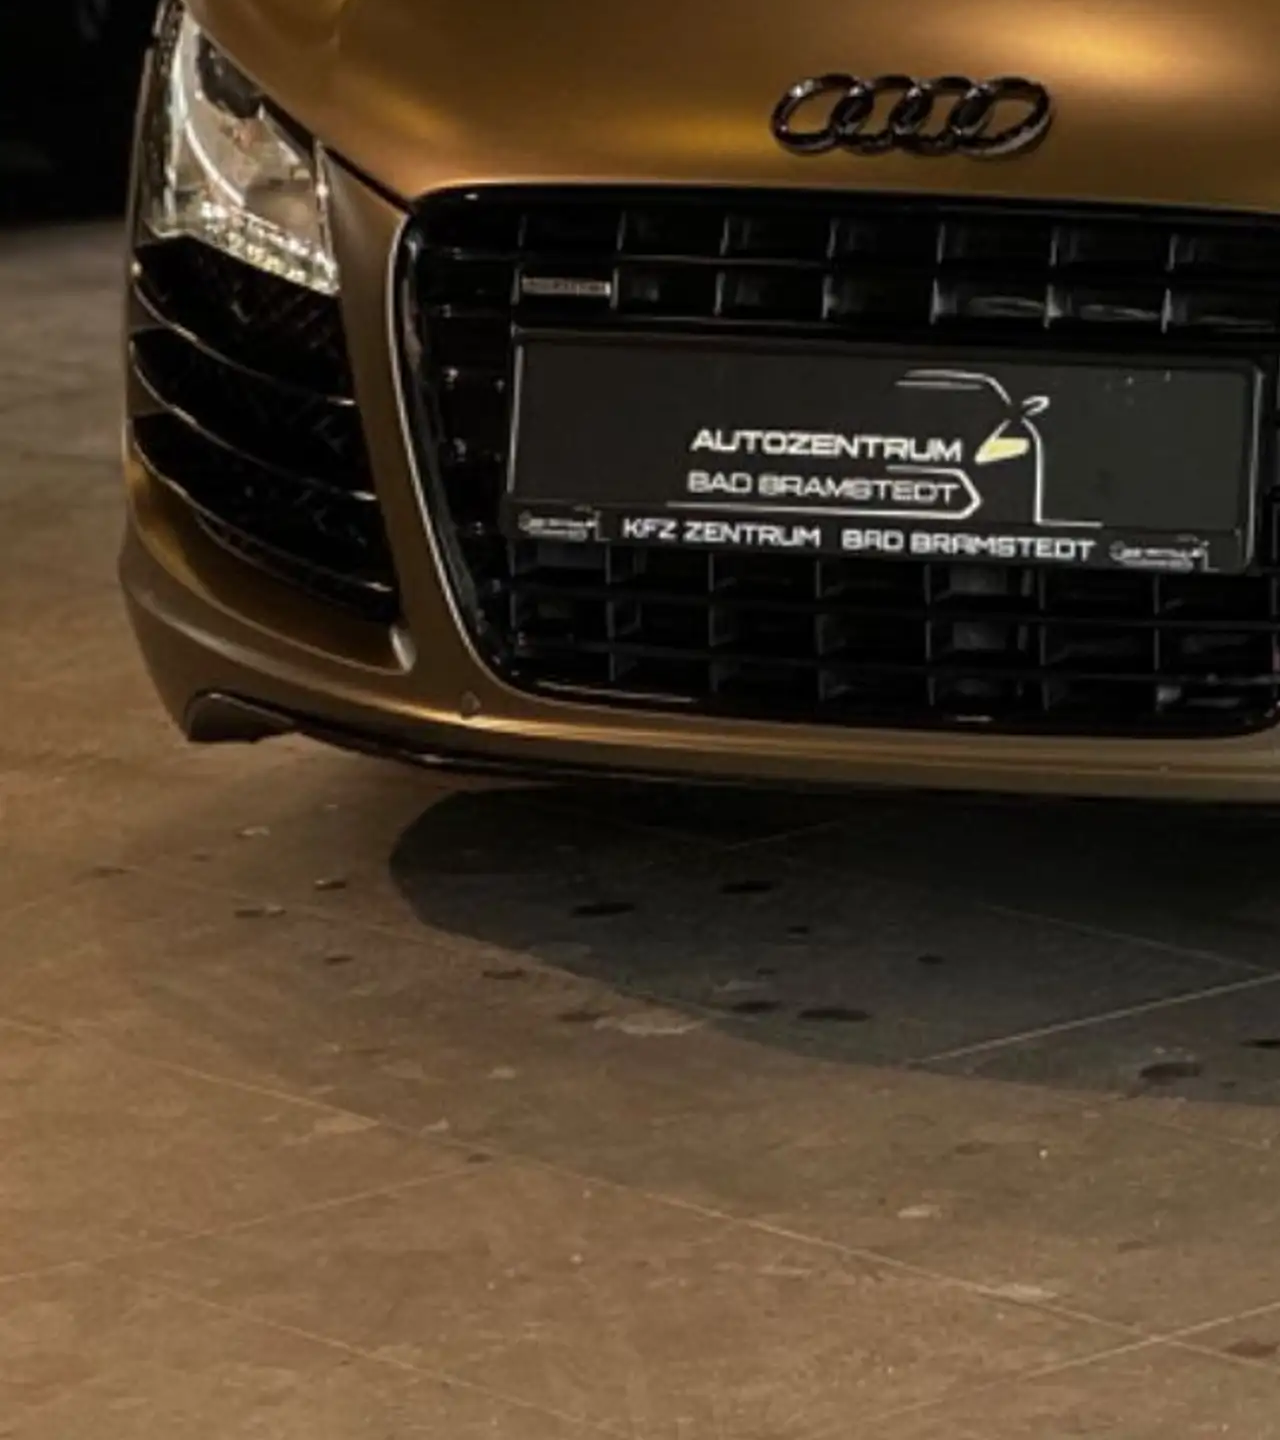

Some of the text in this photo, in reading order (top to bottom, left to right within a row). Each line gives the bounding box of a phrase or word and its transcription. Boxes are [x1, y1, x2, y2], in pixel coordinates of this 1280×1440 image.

[690, 428, 962, 462] AUTOZENTRUM
[687, 469, 960, 504] BAD BRAMSTEDT
[622, 517, 678, 540] KFZ
[683, 519, 822, 548] ZENTRUM
[841, 528, 904, 552] BAD
[909, 531, 1096, 561] BRAMSTEDT
